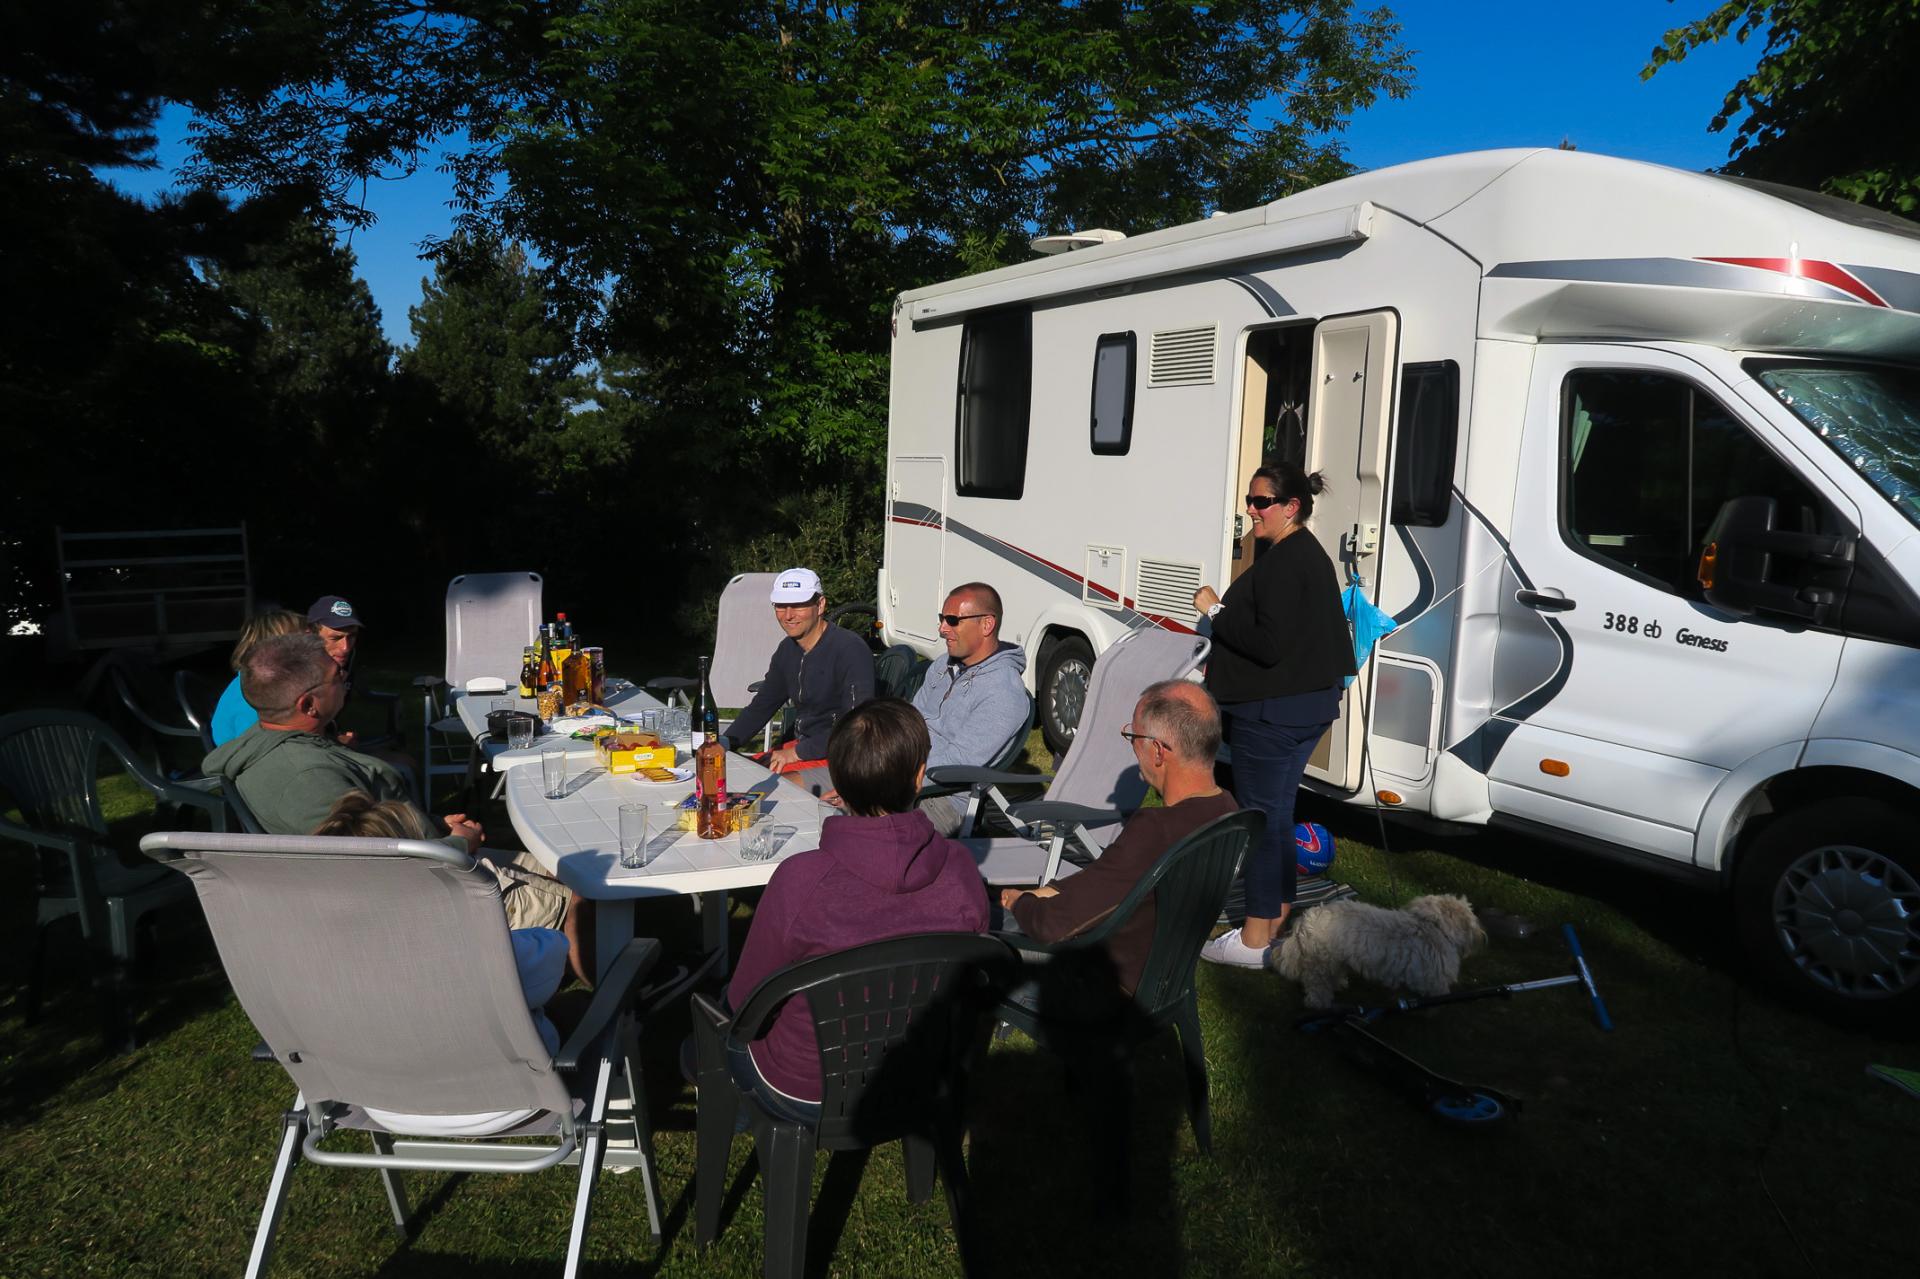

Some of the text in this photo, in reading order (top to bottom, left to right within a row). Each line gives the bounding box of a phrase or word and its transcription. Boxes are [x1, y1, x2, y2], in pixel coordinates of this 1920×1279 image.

[1603, 612, 1729, 652] 388 eb Genesis
